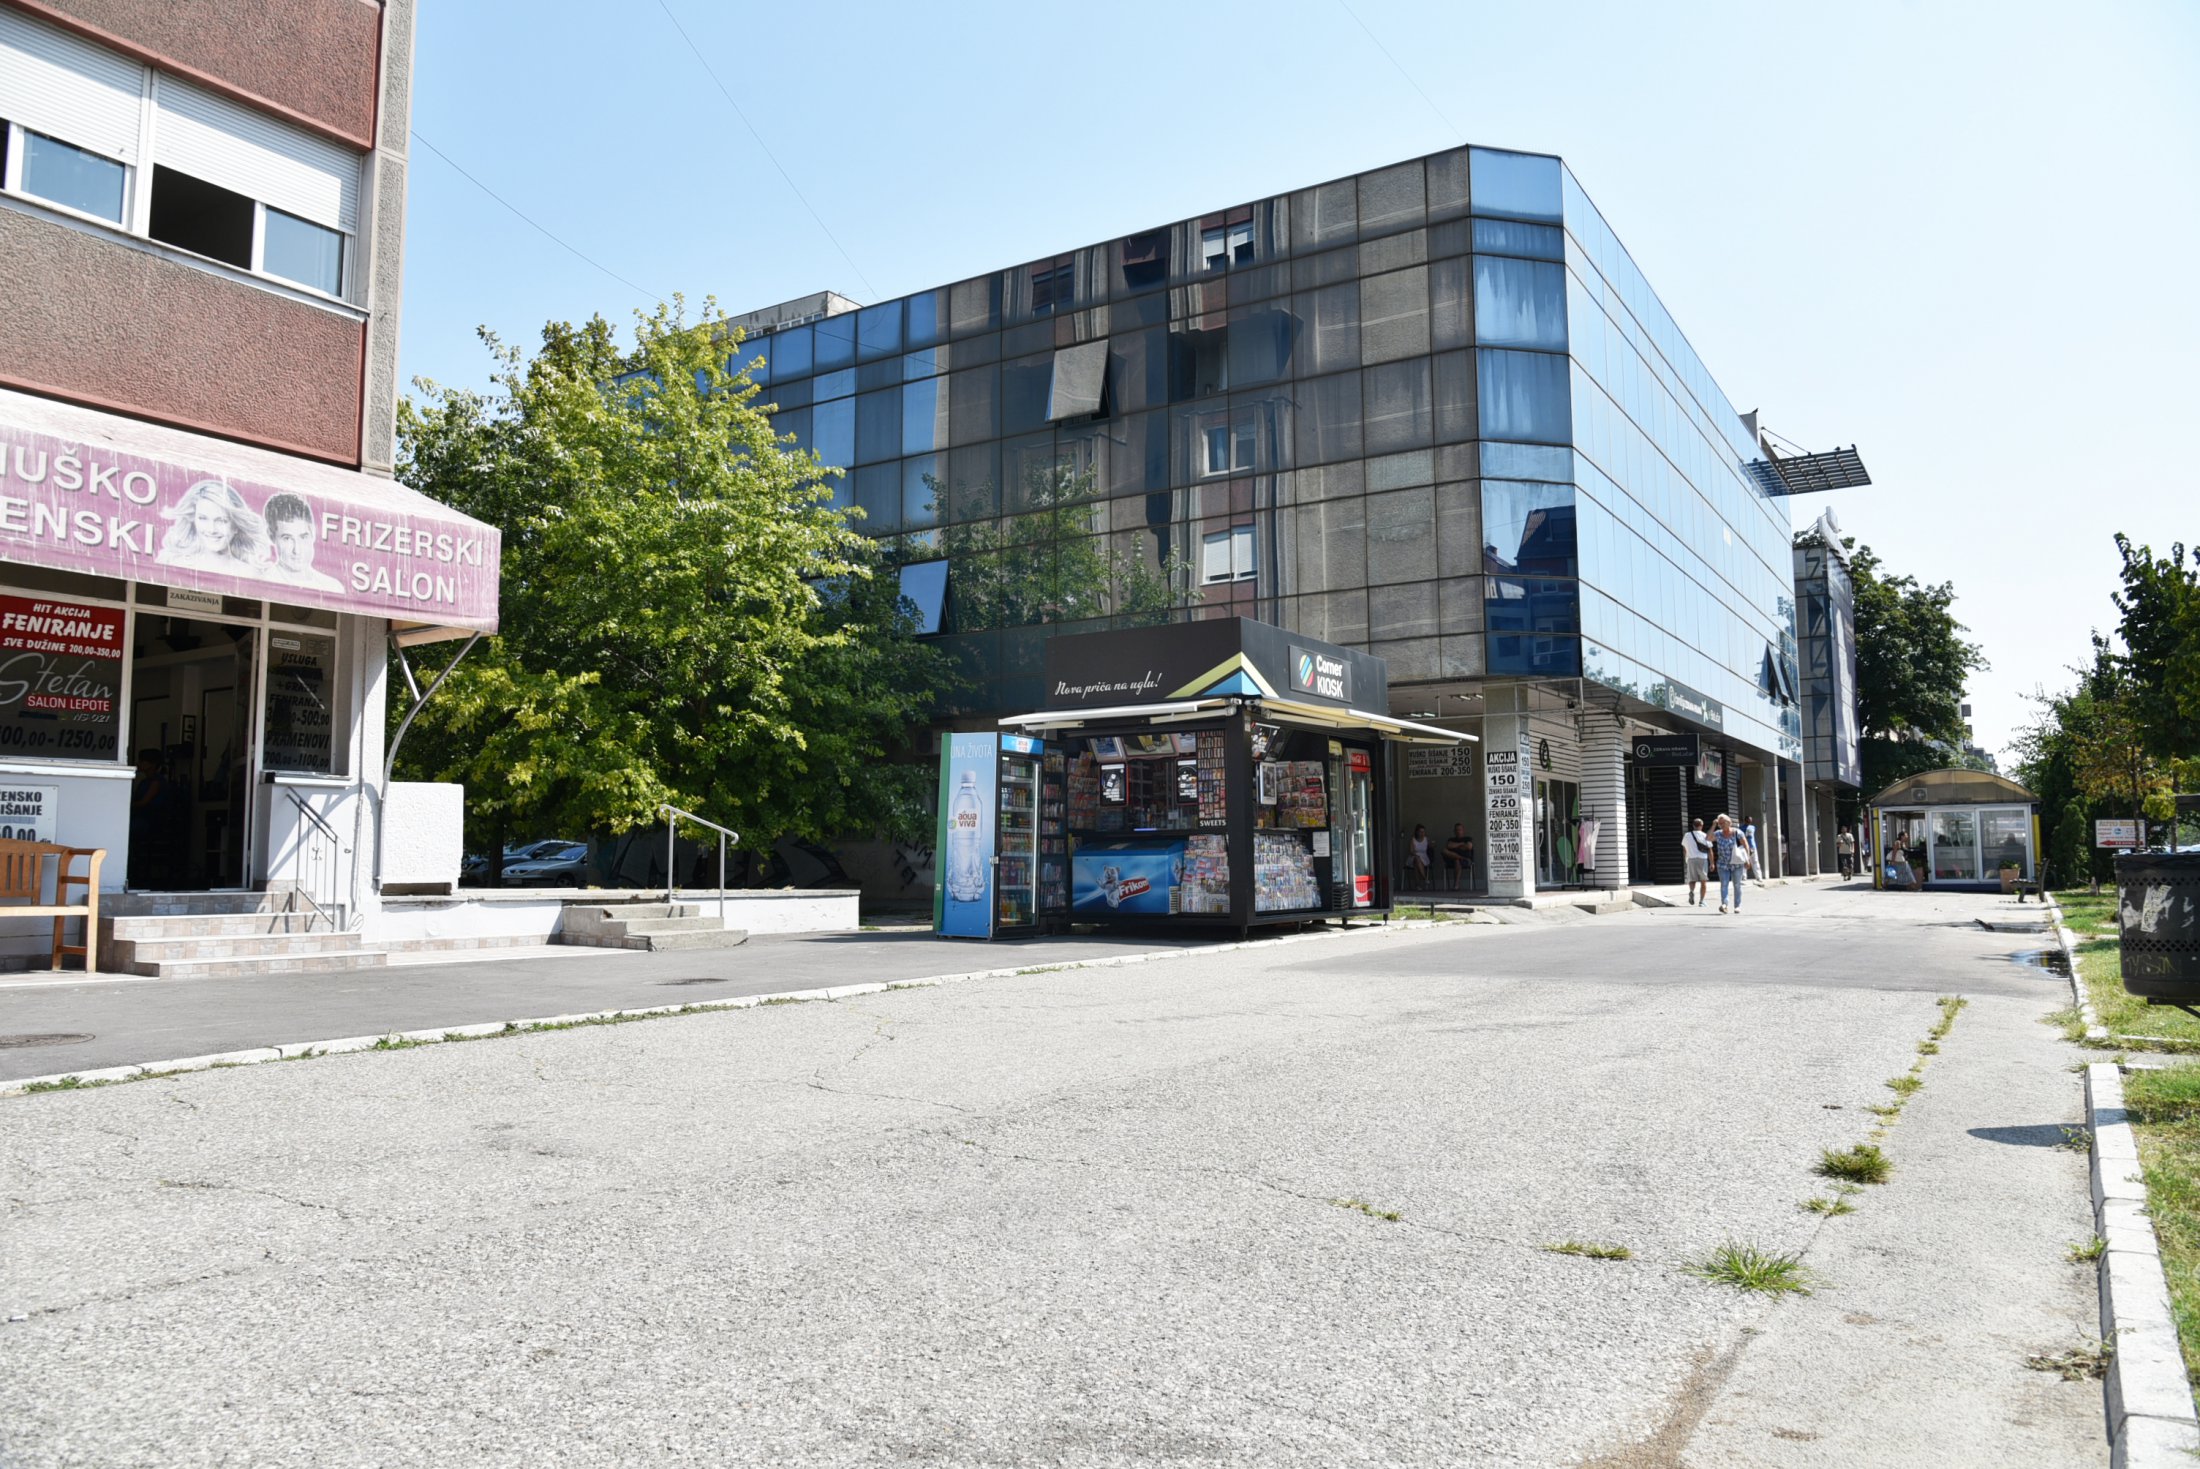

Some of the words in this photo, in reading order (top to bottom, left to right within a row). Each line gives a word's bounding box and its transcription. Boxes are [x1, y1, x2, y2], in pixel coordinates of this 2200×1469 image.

[321, 511, 484, 567] FRIZERSKI
[351, 561, 455, 604] SALON
[169, 592, 220, 606] ZAKAZIVANJA
[33, 603, 52, 613] HIT
[54, 606, 91, 618] AKCIJA
[2, 612, 115, 640] FENIRANJE
[3, 637, 23, 648] SVE
[26, 639, 66, 652] DUŽINE
[1316, 655, 1343, 677] Corner
[0, 652, 113, 705] Stefan
[1055, 681, 1082, 695] Nova
[1082, 682, 1111, 699] priča
[1113, 682, 1128, 691] na
[1130, 670, 1162, 695] uglu!
[1317, 675, 1344, 698] KIOSK
[28, 696, 66, 709] SALON
[70, 698, 110, 711] LEPOTE
[967, 742, 993, 759] ŽIVOTA
[1451, 747, 1470, 756] 150
[1452, 757, 1470, 766] 250
[1489, 752, 1516, 764] AKCIJA
[1441, 766, 1471, 776] 200-350
[1490, 774, 1515, 785] 150
[0, 790, 42, 803] ENSKO
[1491, 799, 1516, 808] 250
[1489, 810, 1519, 818] FENIRANJE
[959, 820, 977, 828] viva
[1199, 819, 1227, 828] SWEETS
[1490, 820, 1519, 830] 200-350
[1491, 842, 1519, 853] 700-1100
